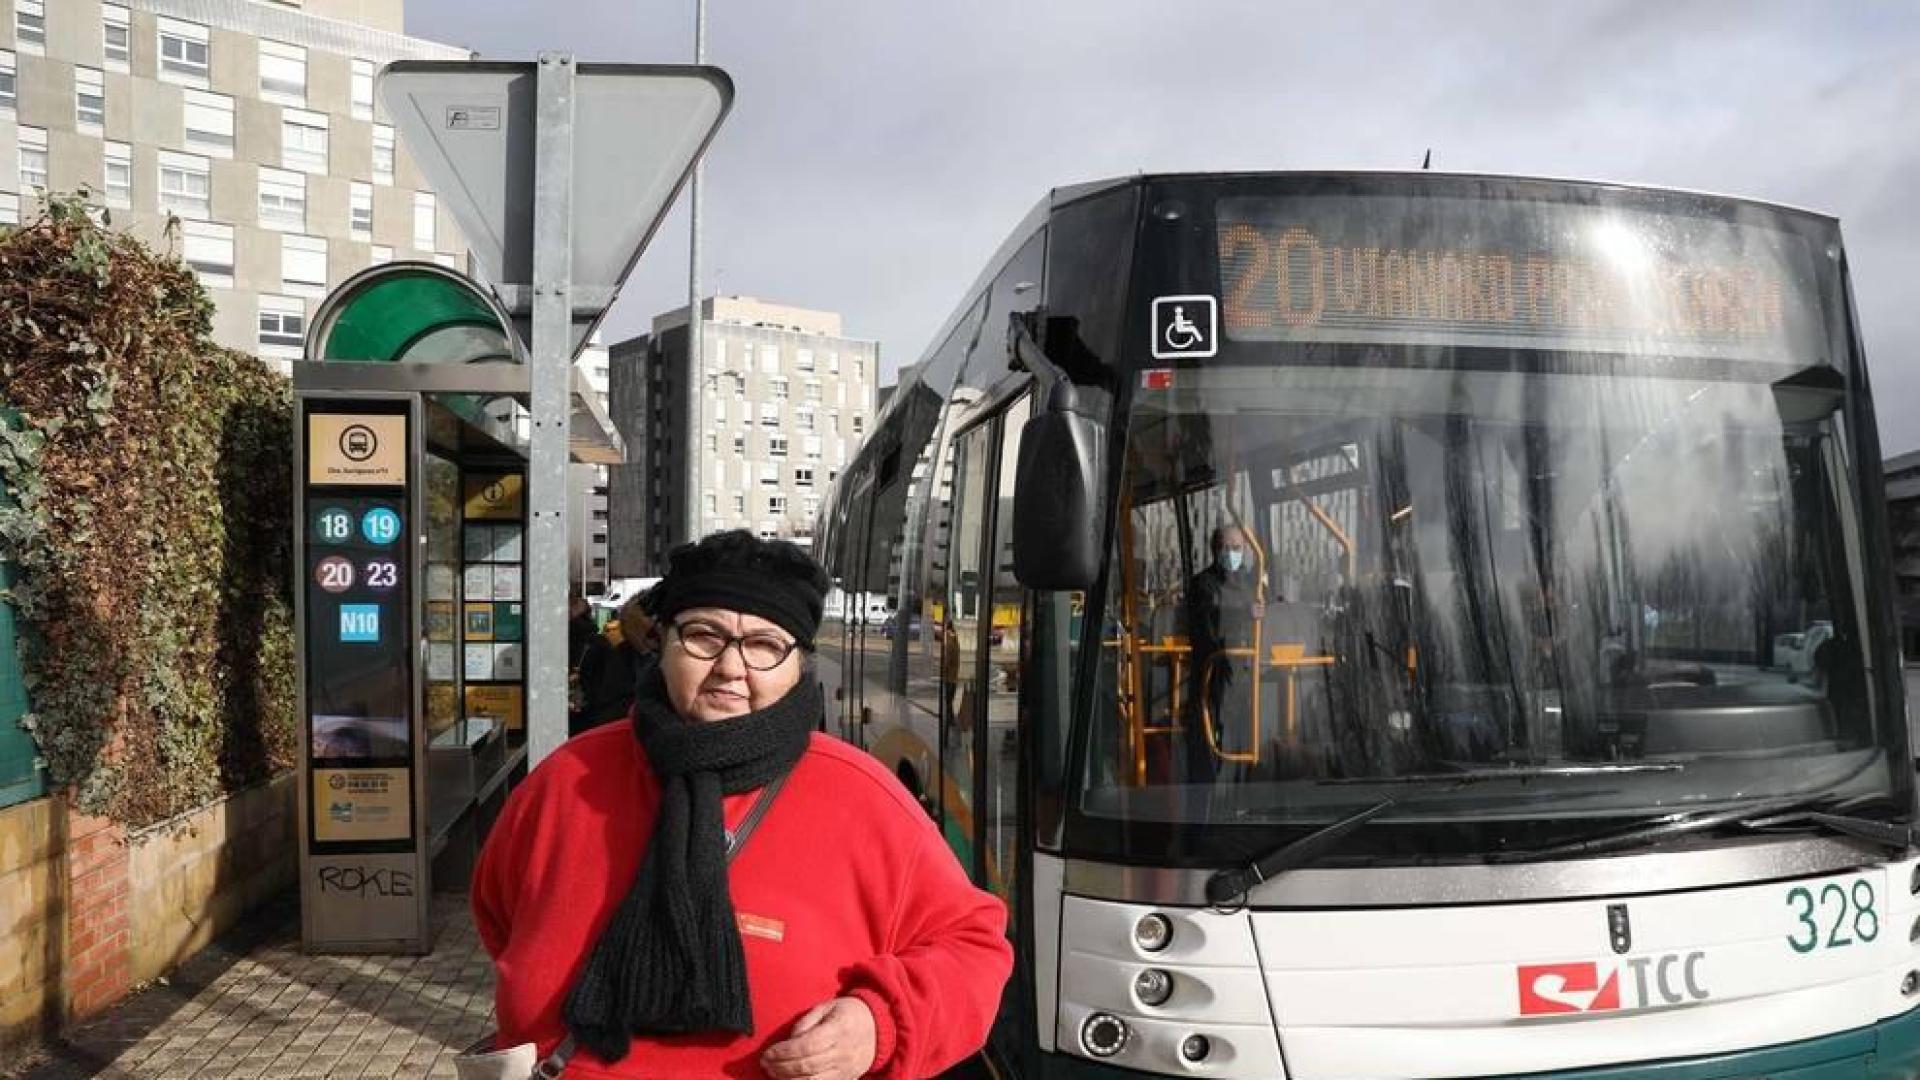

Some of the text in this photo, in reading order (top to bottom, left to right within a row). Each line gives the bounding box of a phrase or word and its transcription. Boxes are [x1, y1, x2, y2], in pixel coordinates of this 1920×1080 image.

[1218, 217, 1325, 328] 20
[321, 513, 395, 538] 18 19
[322, 562, 397, 587] 20 23
[341, 611, 378, 633] N10
[319, 865, 413, 898] ROKE
[1786, 879, 1880, 953] 328
[1627, 951, 1711, 1008] TCC
